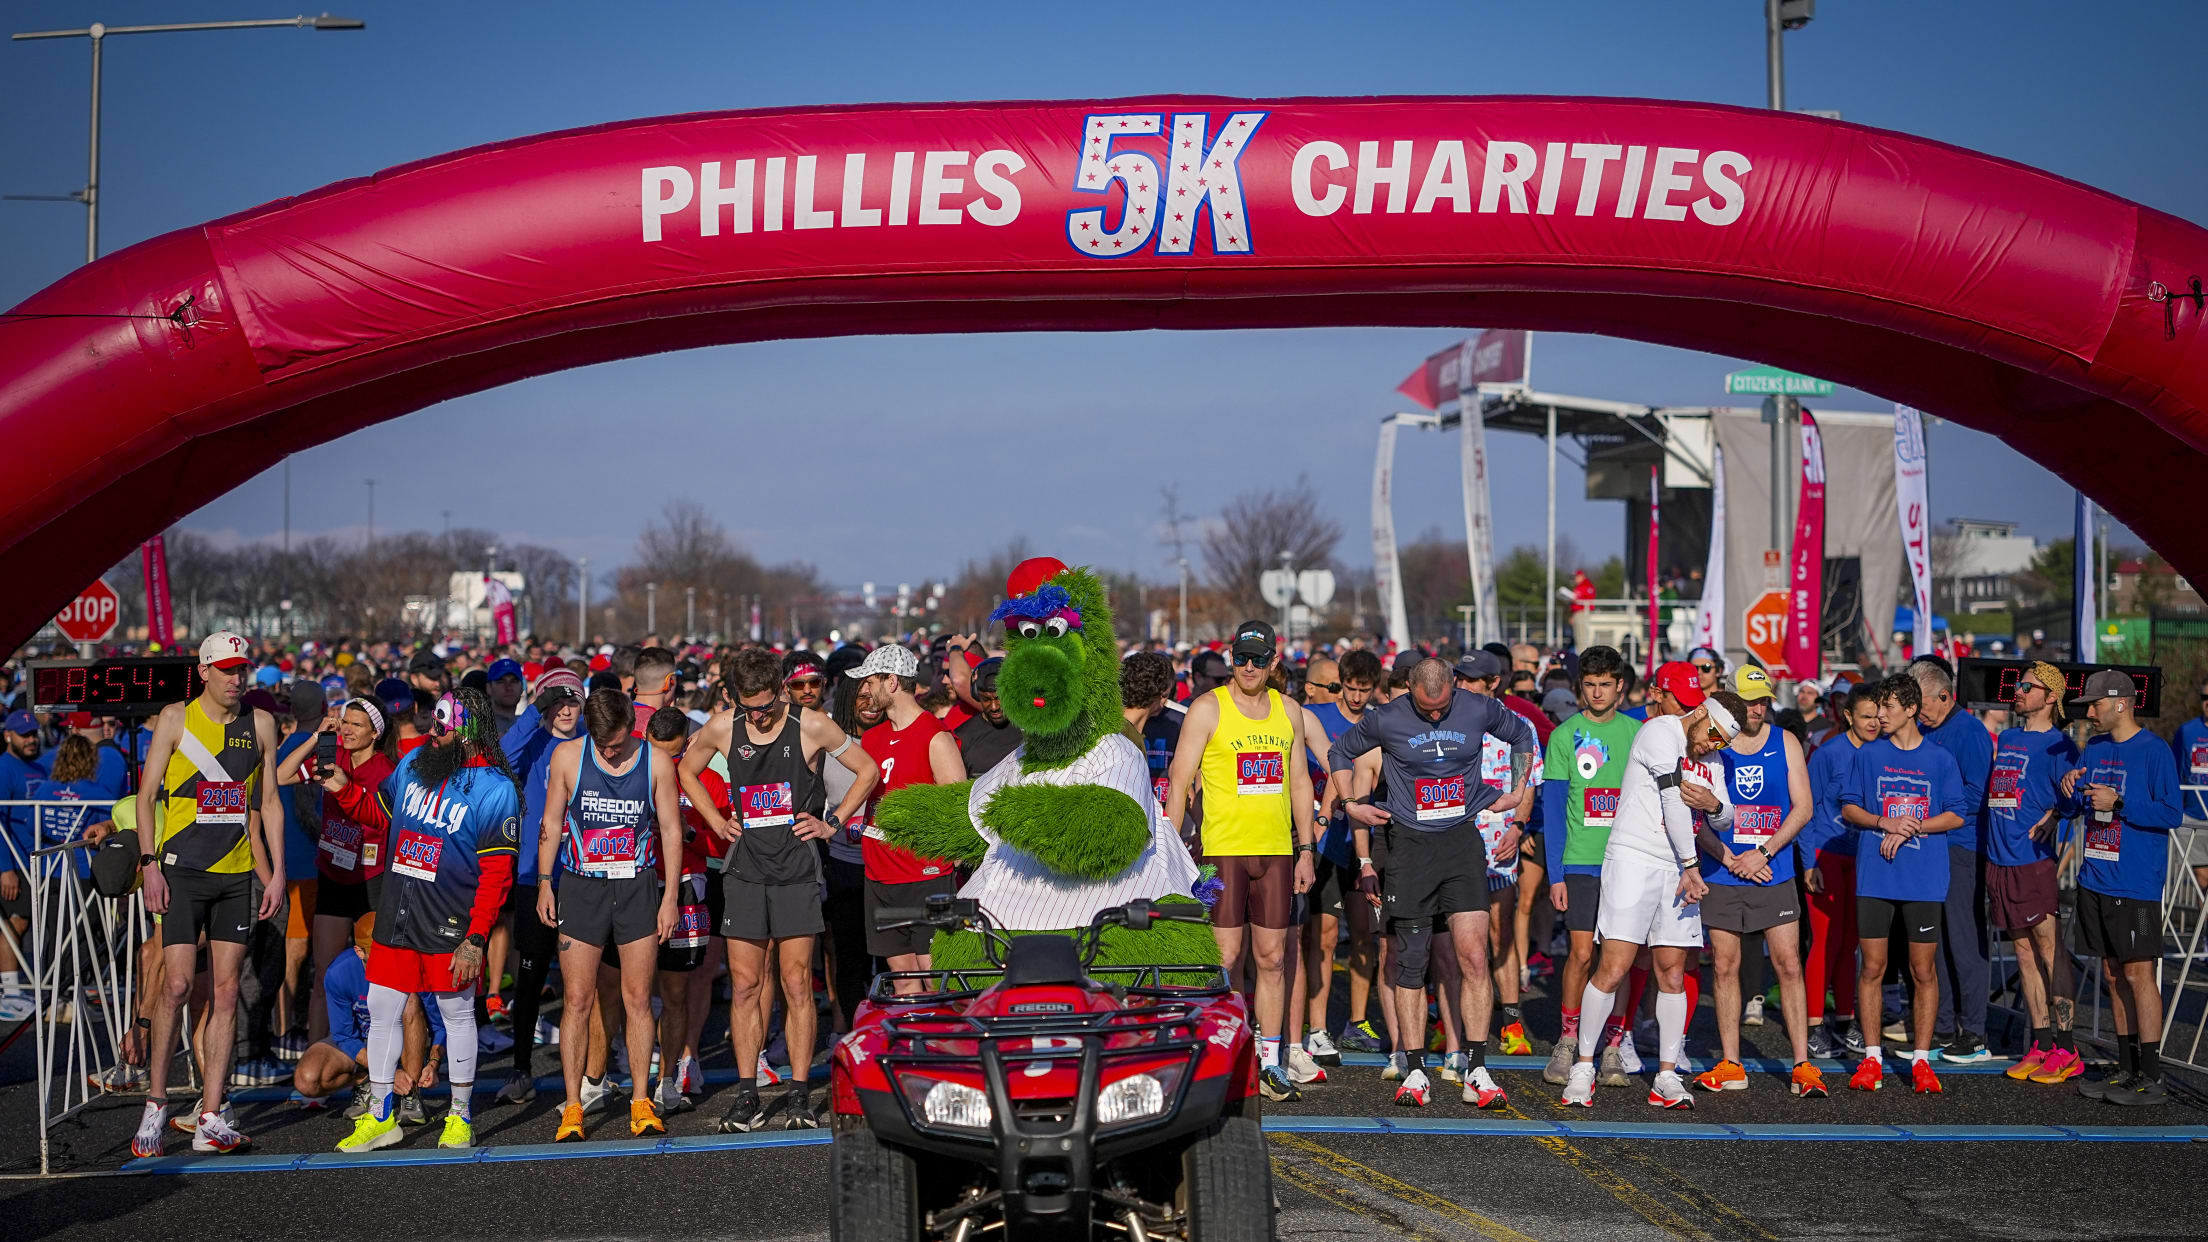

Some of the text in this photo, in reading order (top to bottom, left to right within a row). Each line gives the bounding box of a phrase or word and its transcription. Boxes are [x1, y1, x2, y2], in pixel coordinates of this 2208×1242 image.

[641, 111, 1753, 259] PHILLIES 5K CHARITIES
[1735, 375, 1783, 392] CITIZENS
[1785, 377, 1816, 393] BANK
[57, 596, 115, 623] STOP
[1750, 613, 1789, 645] ST
[229, 738, 252, 749] GSTC
[1231, 734, 1289, 751] IN TRAINING
[1408, 730, 1467, 749] DELAWARE
[1242, 759, 1277, 777] 6477
[1737, 775, 1762, 784] TWM
[203, 788, 239, 807] 2315
[1420, 783, 1460, 803] 3012
[402, 781, 469, 835] PHILLY
[581, 797, 645, 815] FREEDOM
[583, 812, 639, 824] ATHLETICS
[1740, 811, 1773, 829] 2317
[326, 820, 358, 843] 3207
[400, 839, 435, 864] 4473
[588, 837, 629, 856] 4012
[1014, 1004, 1069, 1013] RECON
